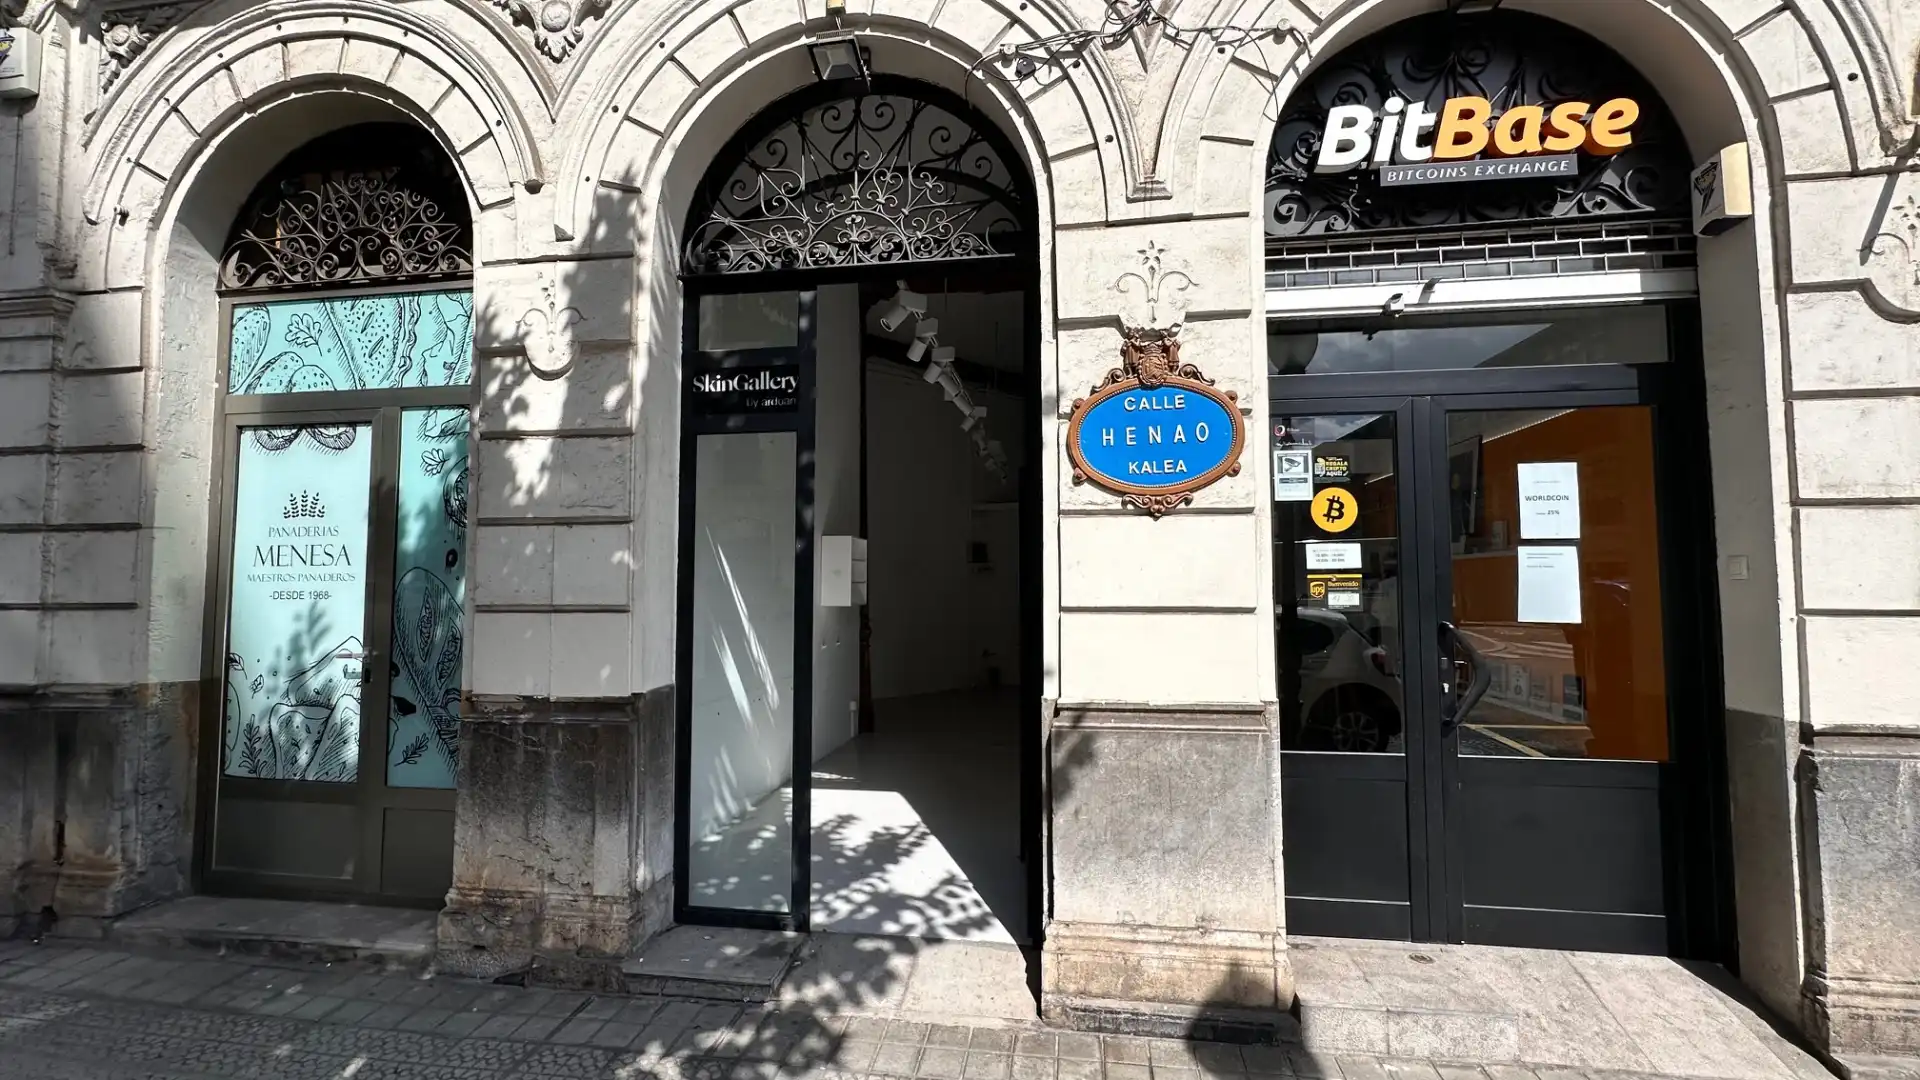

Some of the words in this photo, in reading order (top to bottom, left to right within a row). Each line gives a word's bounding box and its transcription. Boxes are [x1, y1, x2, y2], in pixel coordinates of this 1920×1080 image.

[1315, 96, 1640, 169] BitBase
[1387, 167, 1467, 182] BITCOINS
[1474, 160, 1569, 177] EXCHANGE
[693, 370, 799, 393] SkinGallery
[1124, 394, 1186, 411] CALLE
[1102, 421, 1210, 447] HENAO
[1128, 459, 1188, 475] KALEA
[1525, 494, 1569, 502] WORLDCOIN
[268, 525, 339, 538] PANADERIAS
[252, 543, 351, 567] MENESA
[246, 573, 296, 583] MAESTROS
[297, 572, 356, 582] PANADEROS
